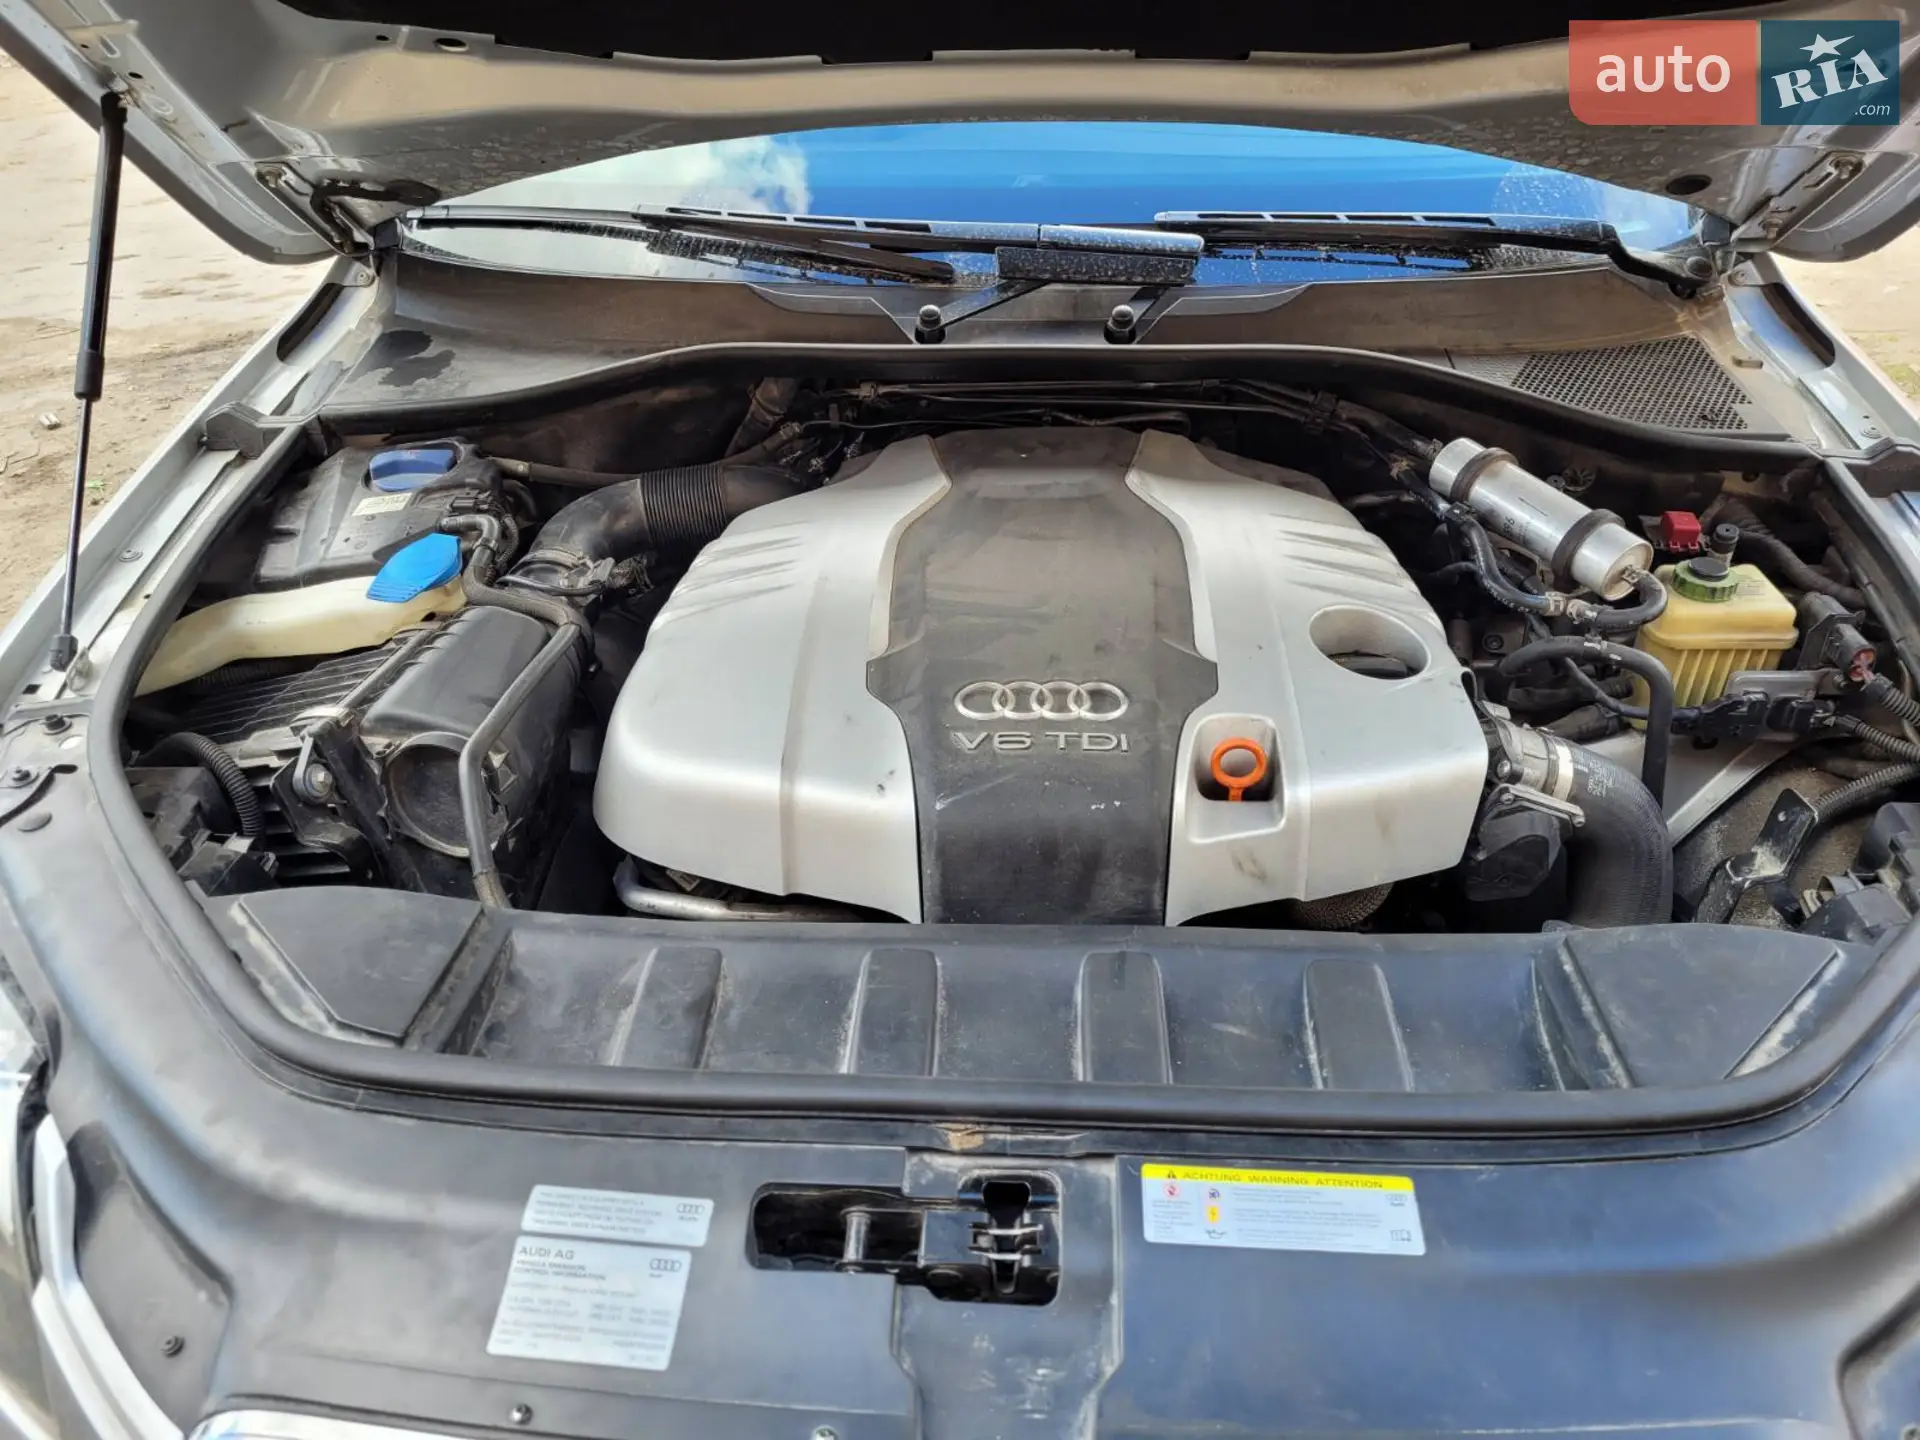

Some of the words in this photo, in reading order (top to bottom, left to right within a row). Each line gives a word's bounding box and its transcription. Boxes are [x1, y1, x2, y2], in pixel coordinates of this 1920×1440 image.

[952, 731, 1032, 751] V6
[1045, 731, 1130, 752] TDI
[1183, 1171, 1242, 1182] ACHTUNG
[1249, 1175, 1310, 1185] WARNING
[1316, 1178, 1383, 1188] ATTENTION
[518, 1246, 551, 1258] AUDI
[555, 1249, 575, 1260] AG
